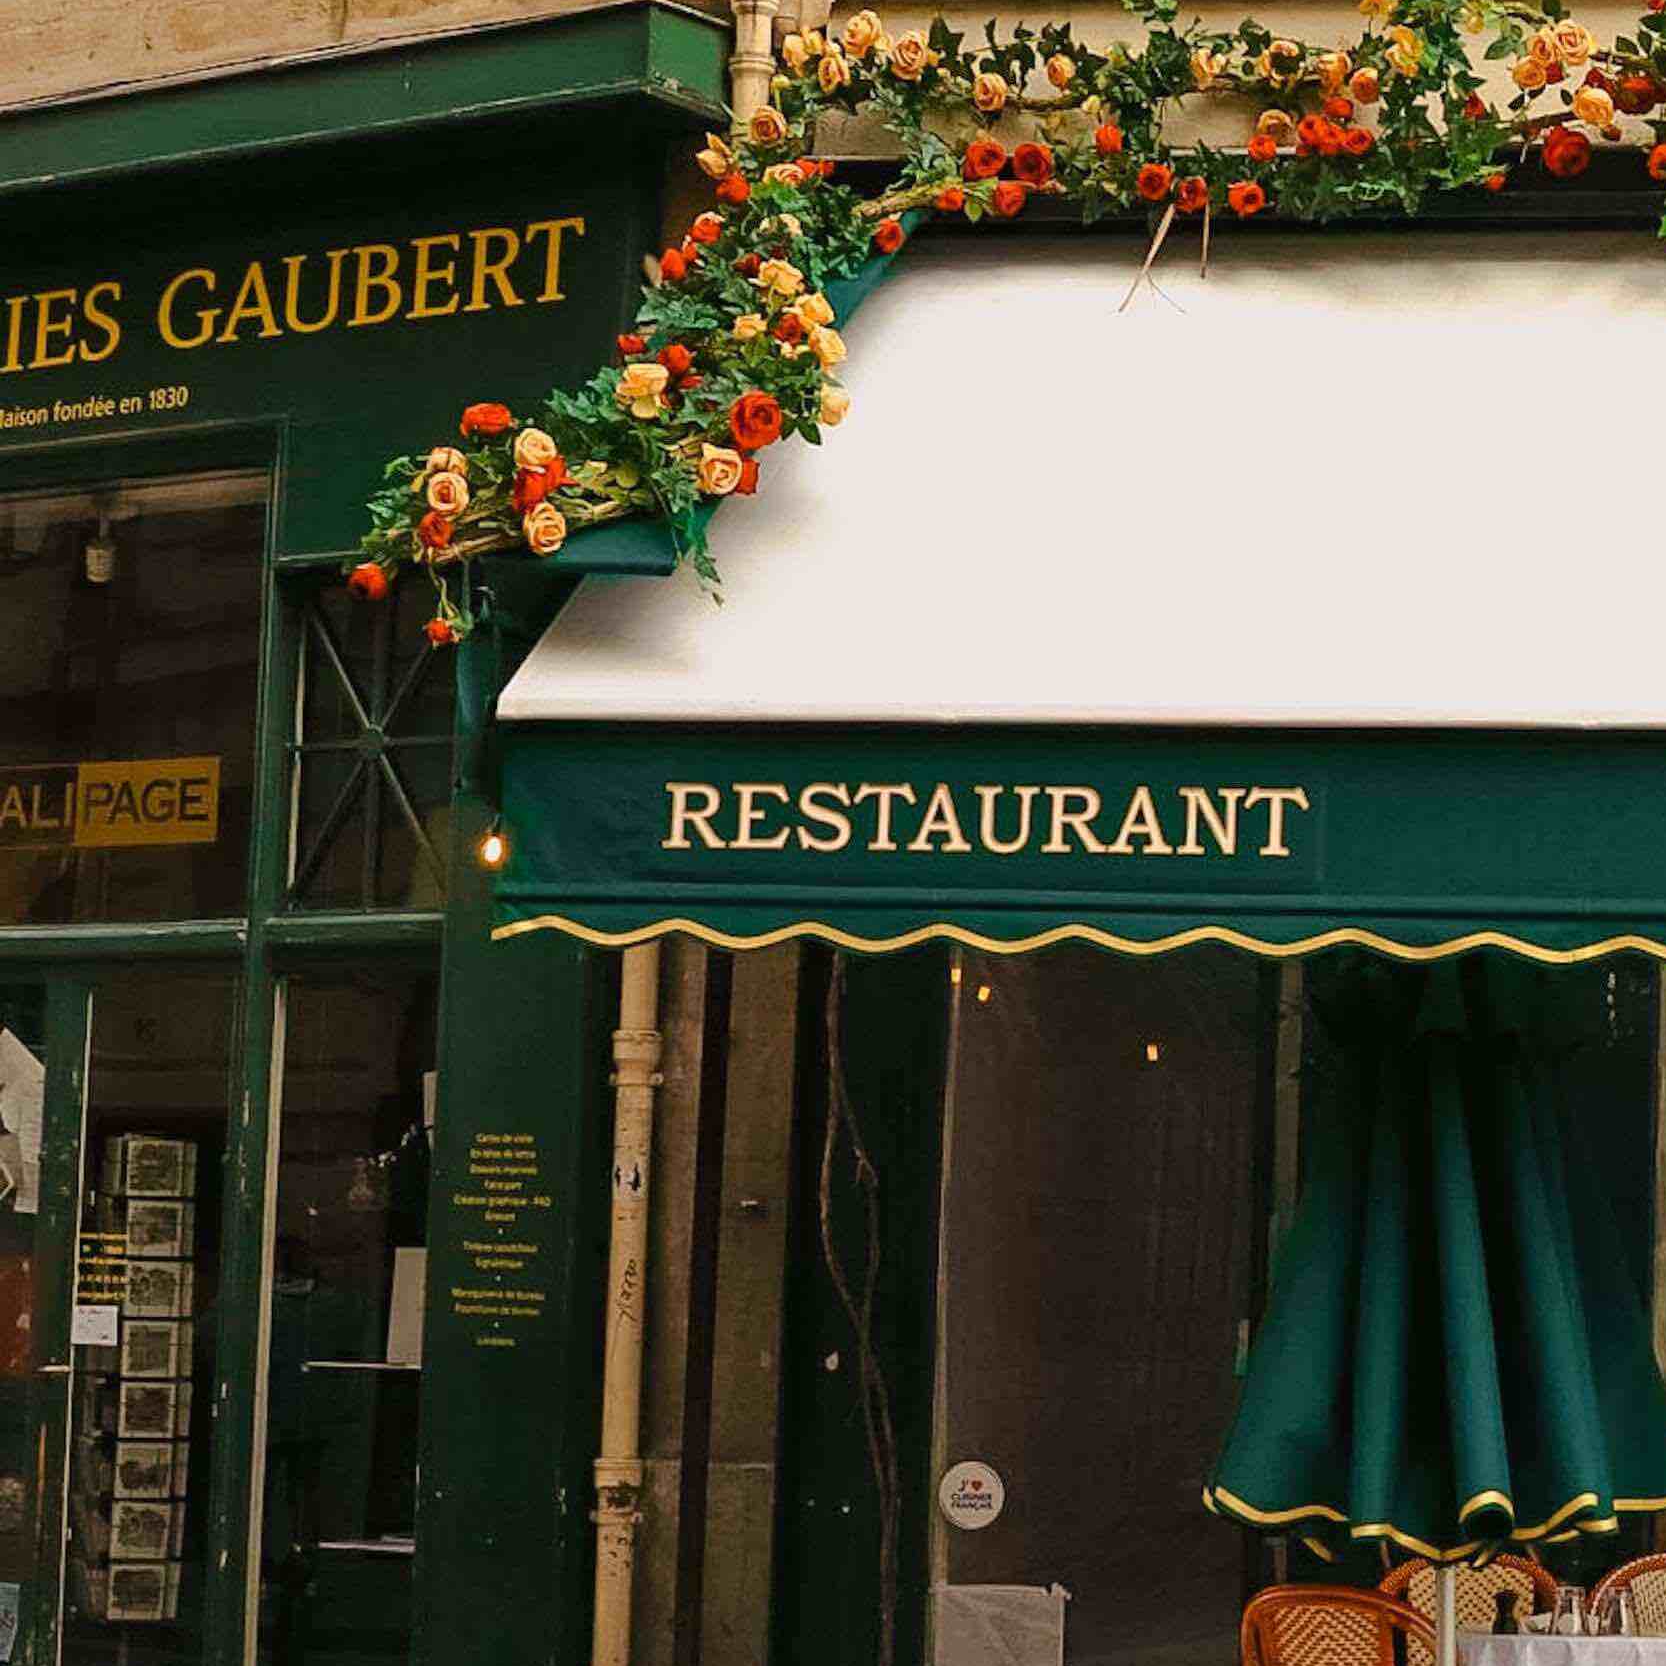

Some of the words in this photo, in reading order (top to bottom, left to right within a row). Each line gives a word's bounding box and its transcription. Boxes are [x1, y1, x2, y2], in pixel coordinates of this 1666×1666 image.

[157, 216, 585, 350] GAUBERT
[53, 395, 116, 422] fondée
[119, 396, 143, 415] en
[149, 385, 189, 411] 1830
[661, 781, 1310, 857] RESTAURANT
